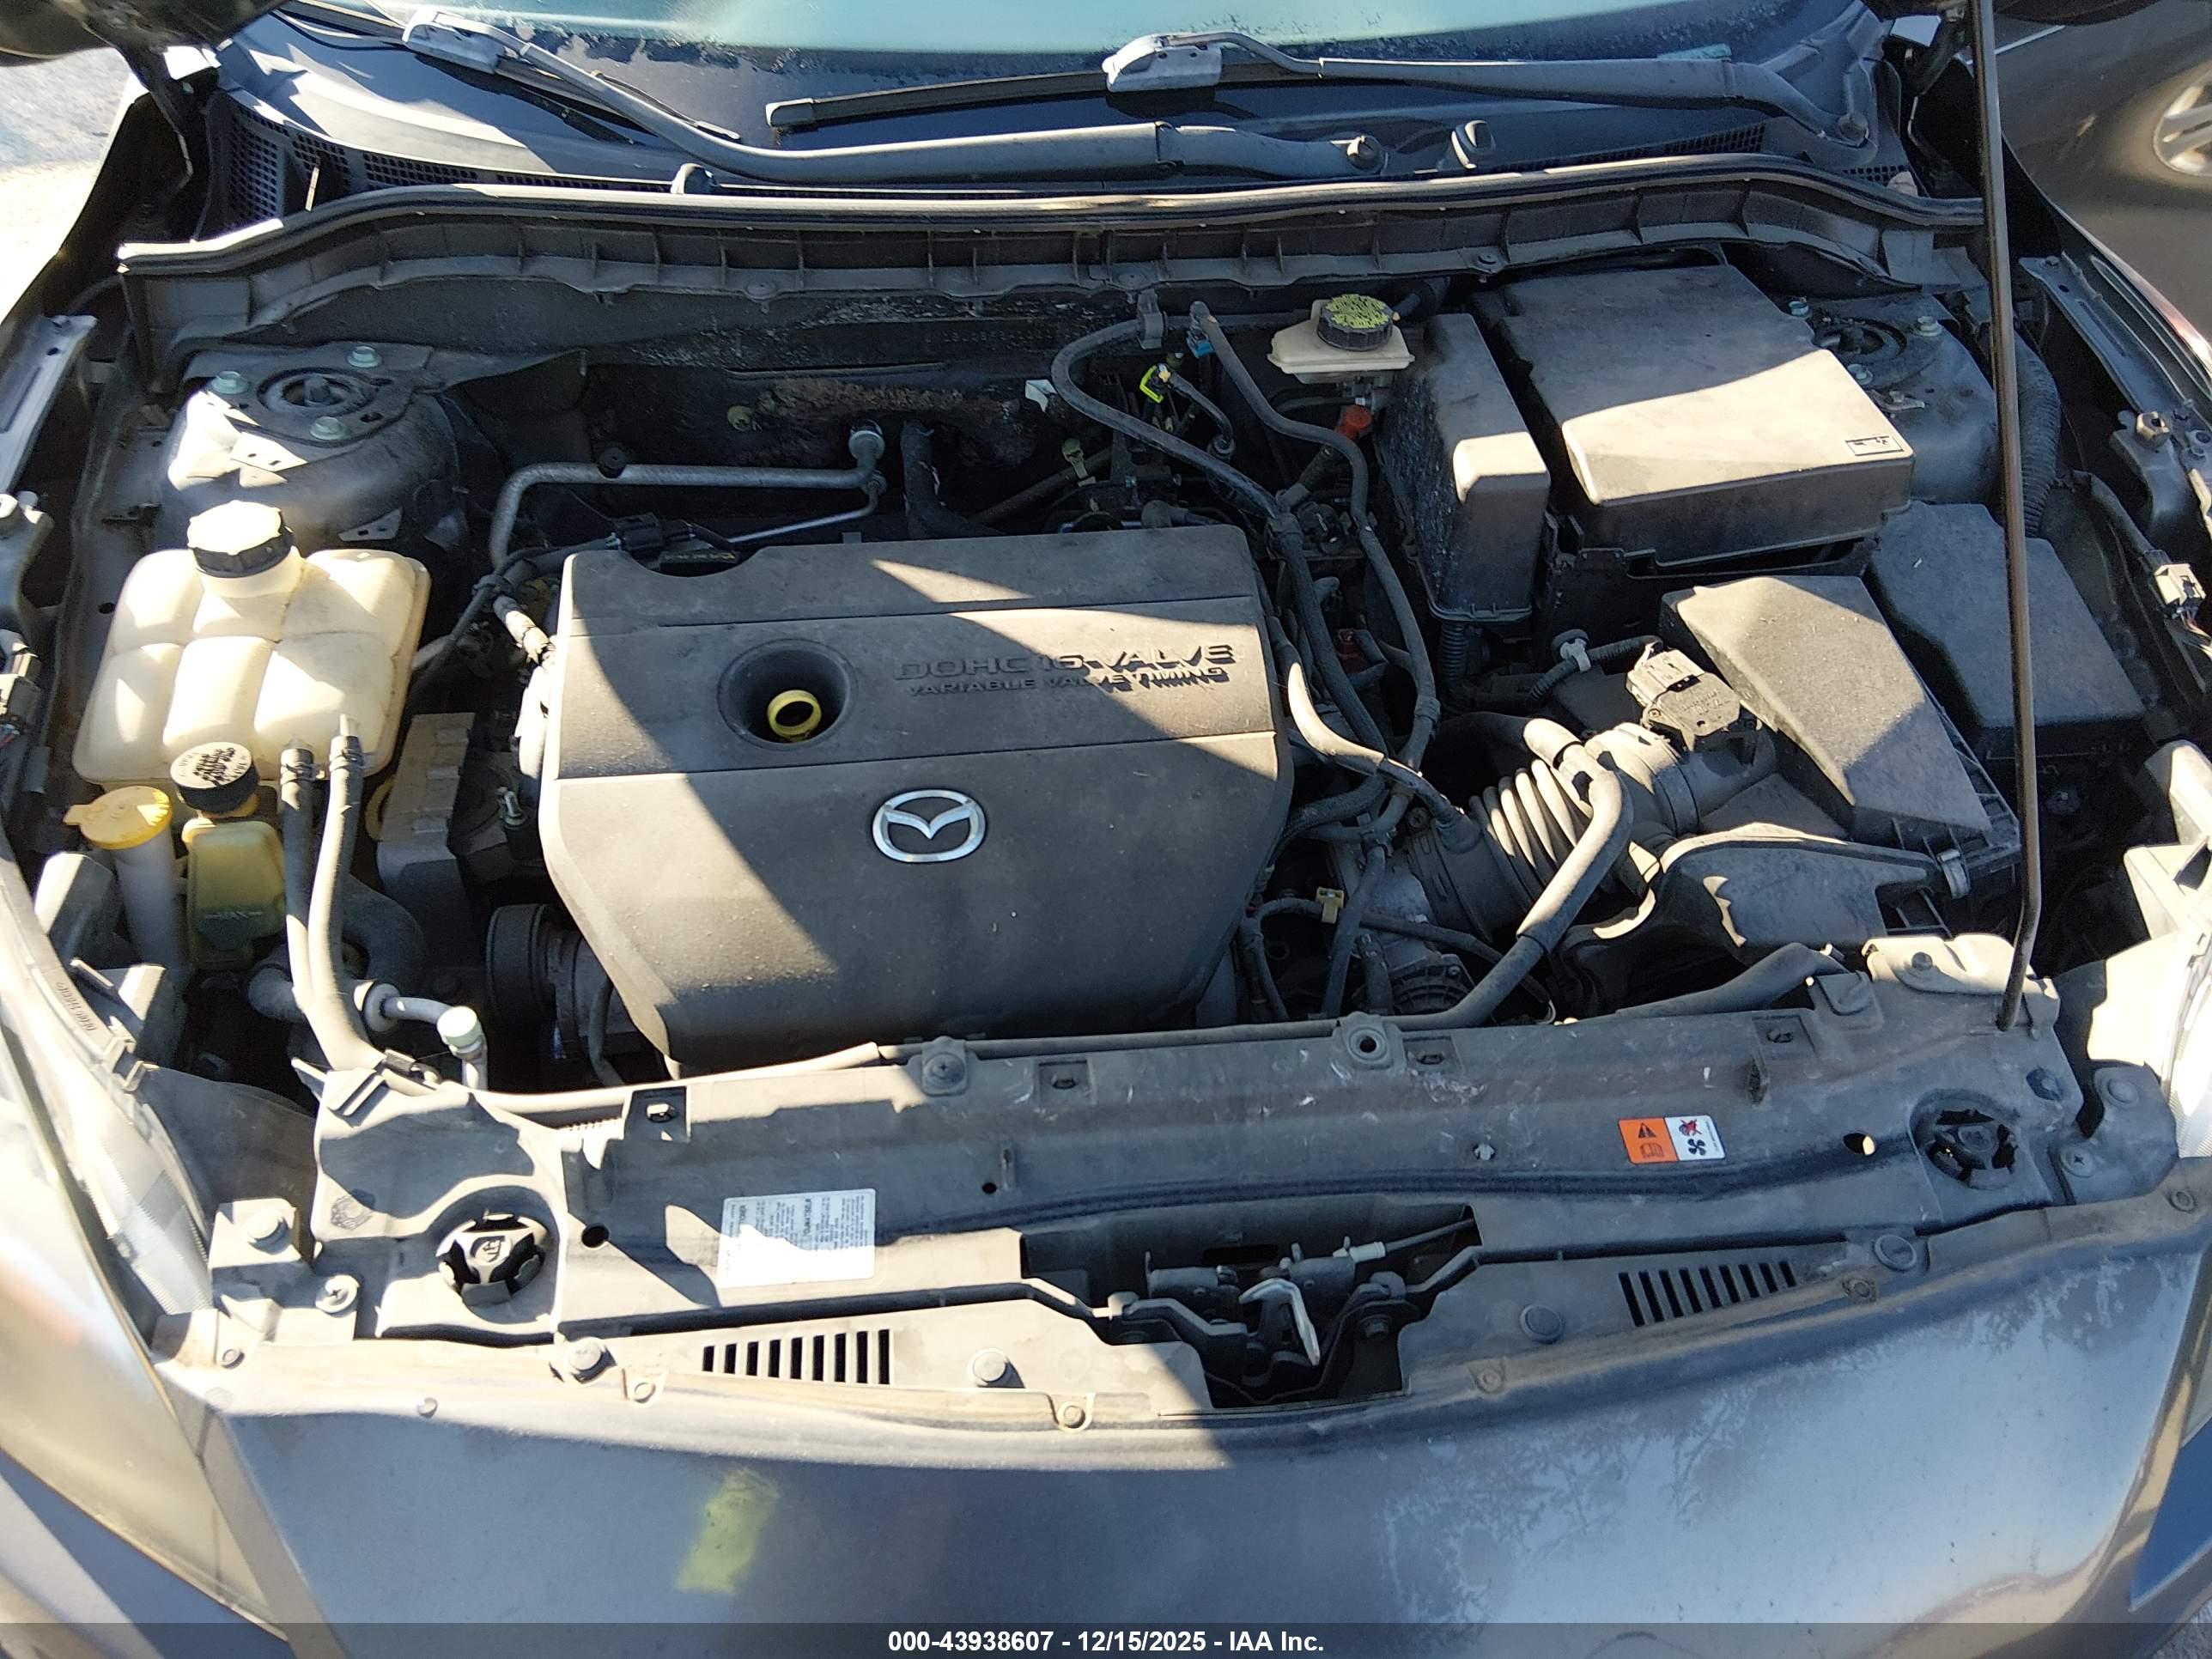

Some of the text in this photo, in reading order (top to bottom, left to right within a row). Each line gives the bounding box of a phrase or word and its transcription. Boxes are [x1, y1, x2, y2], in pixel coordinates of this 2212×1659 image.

[894, 644, 1236, 680] DOHC 16-VALVE
[908, 678, 1036, 696] VARIABLE
[1133, 667, 1230, 689] TIMING
